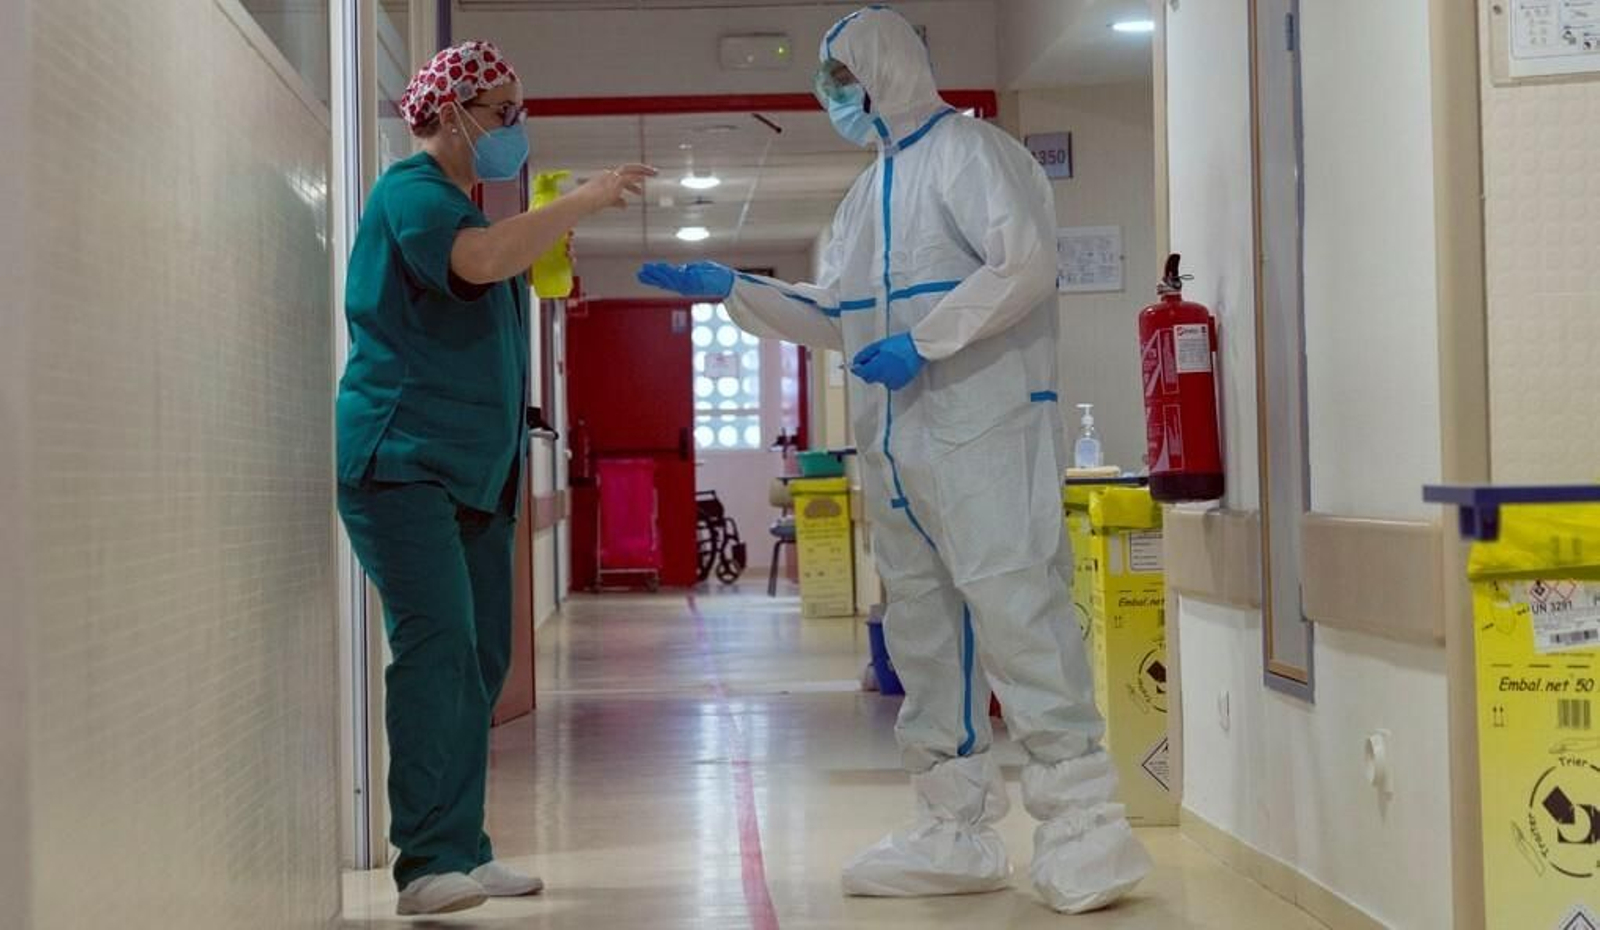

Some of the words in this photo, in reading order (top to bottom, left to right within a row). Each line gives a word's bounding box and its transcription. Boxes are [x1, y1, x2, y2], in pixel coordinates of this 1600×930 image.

[1531, 602, 1547, 614] UN
[1550, 600, 1573, 612] 3291
[1499, 676, 1569, 692] Embal.net
[1574, 678, 1595, 692] 50
[1558, 756, 1588, 768] Trier
